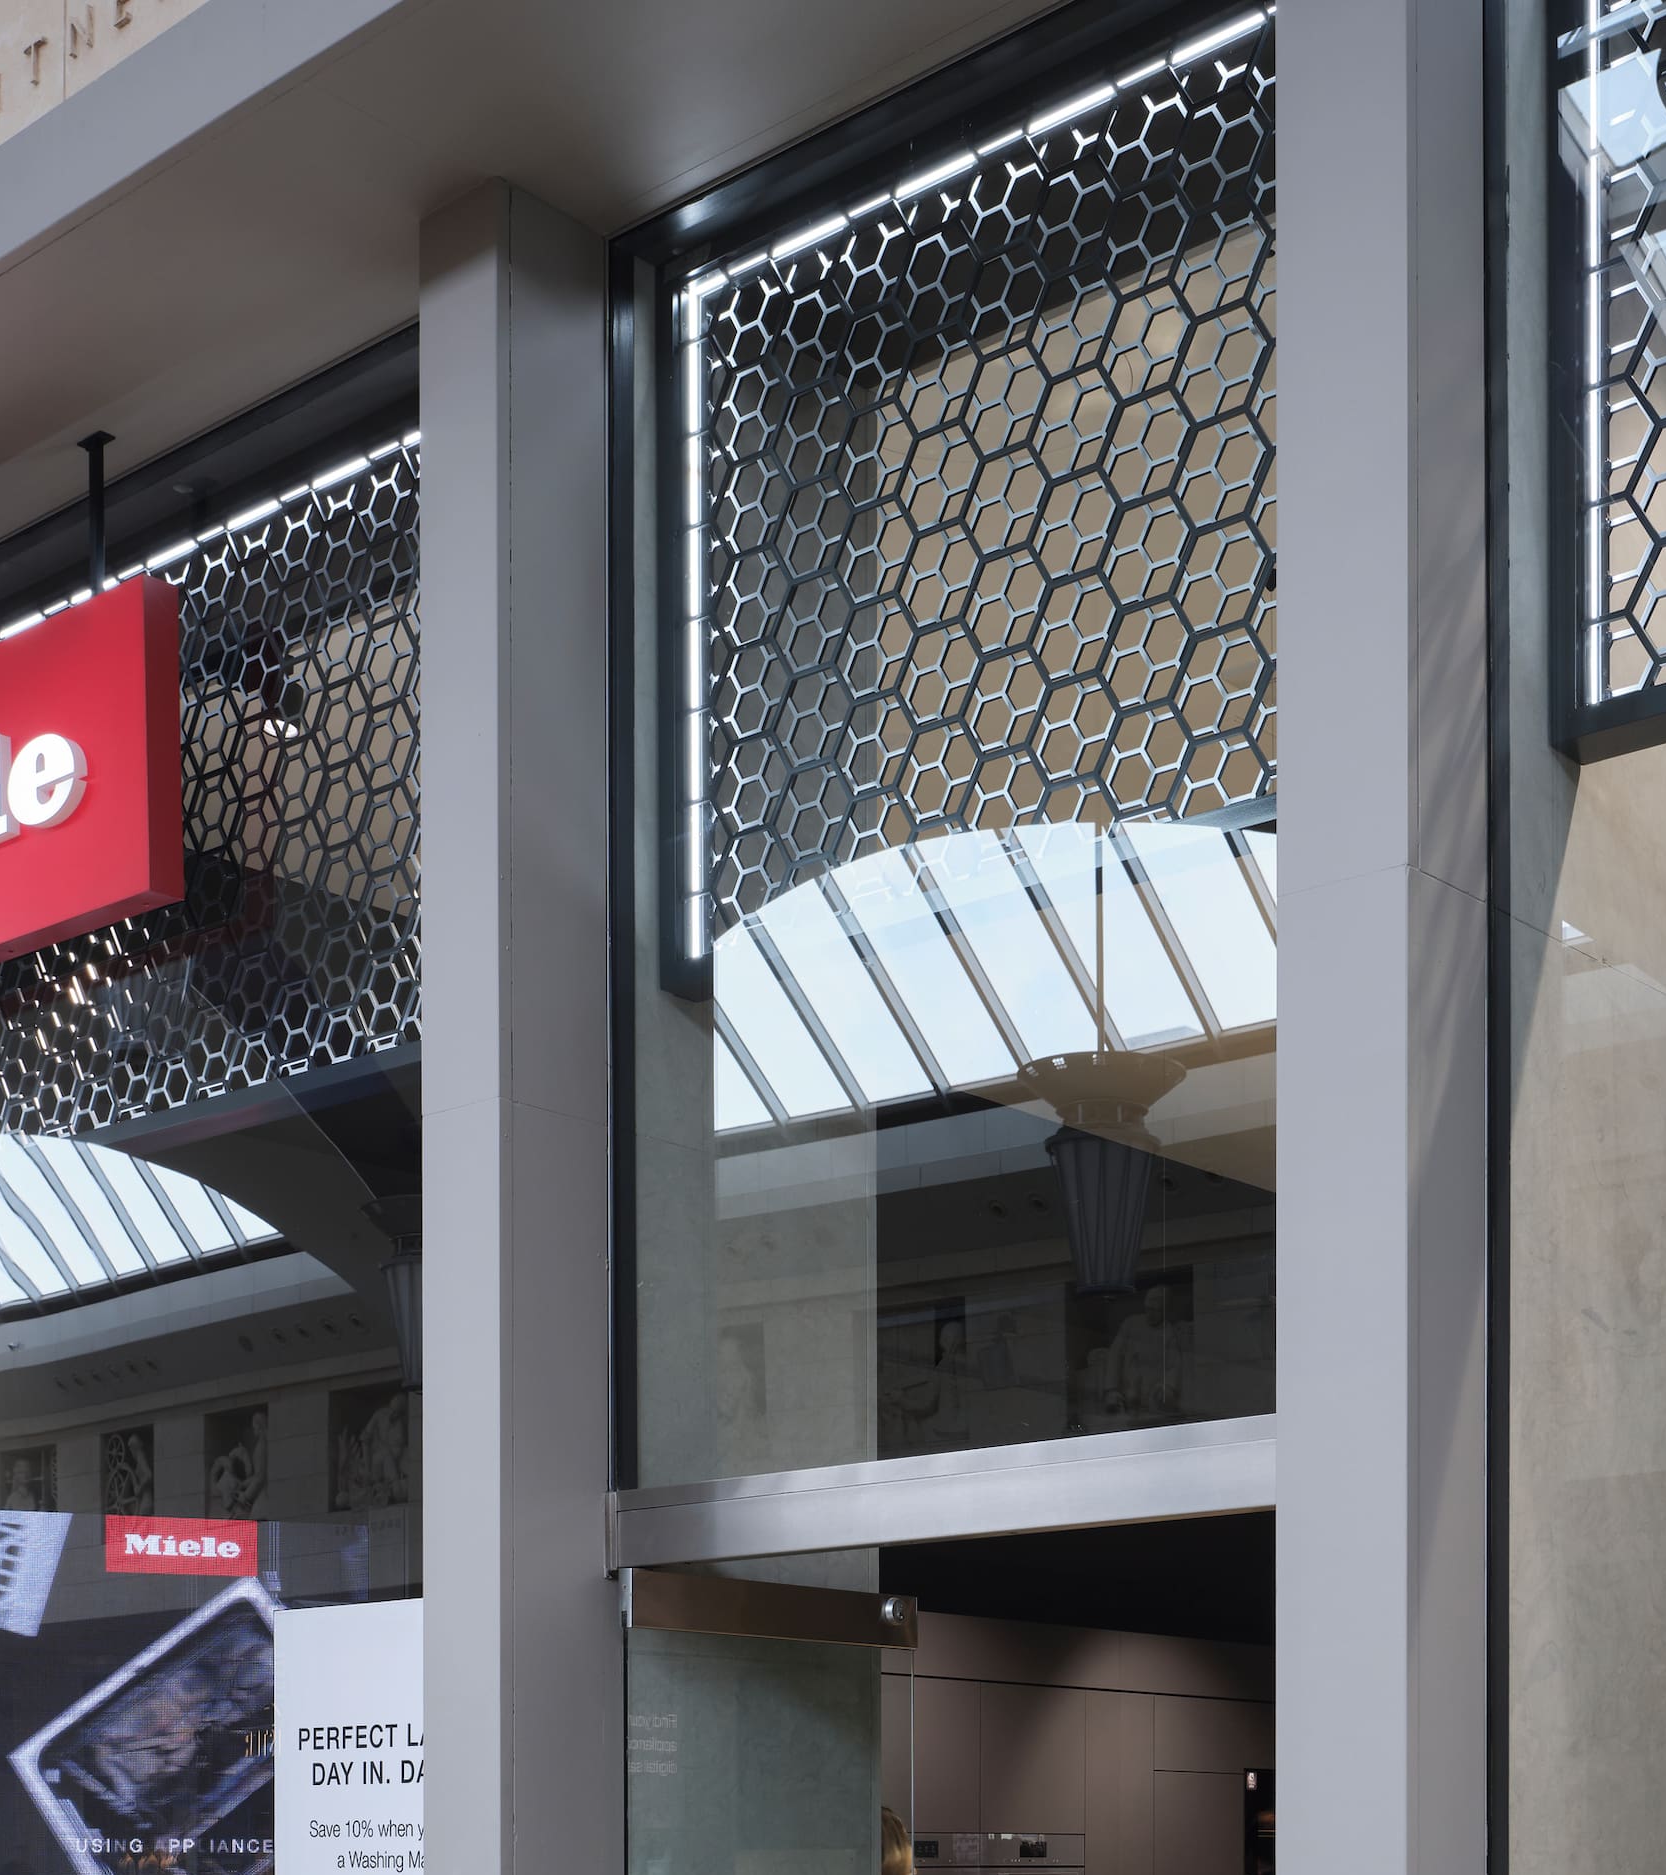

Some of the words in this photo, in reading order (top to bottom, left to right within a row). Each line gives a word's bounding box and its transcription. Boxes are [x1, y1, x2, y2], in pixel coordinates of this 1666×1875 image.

[123, 1533, 241, 1559] Miele
[298, 1724, 398, 1751] PERFECT
[312, 1761, 354, 1786] DAY
[363, 1760, 390, 1785] IN.
[309, 1820, 341, 1838] Save
[345, 1819, 374, 1838] 10%
[378, 1819, 414, 1838] when
[76, 1838, 144, 1854] USING
[337, 1855, 345, 1869] a
[348, 1850, 404, 1873] Washing
